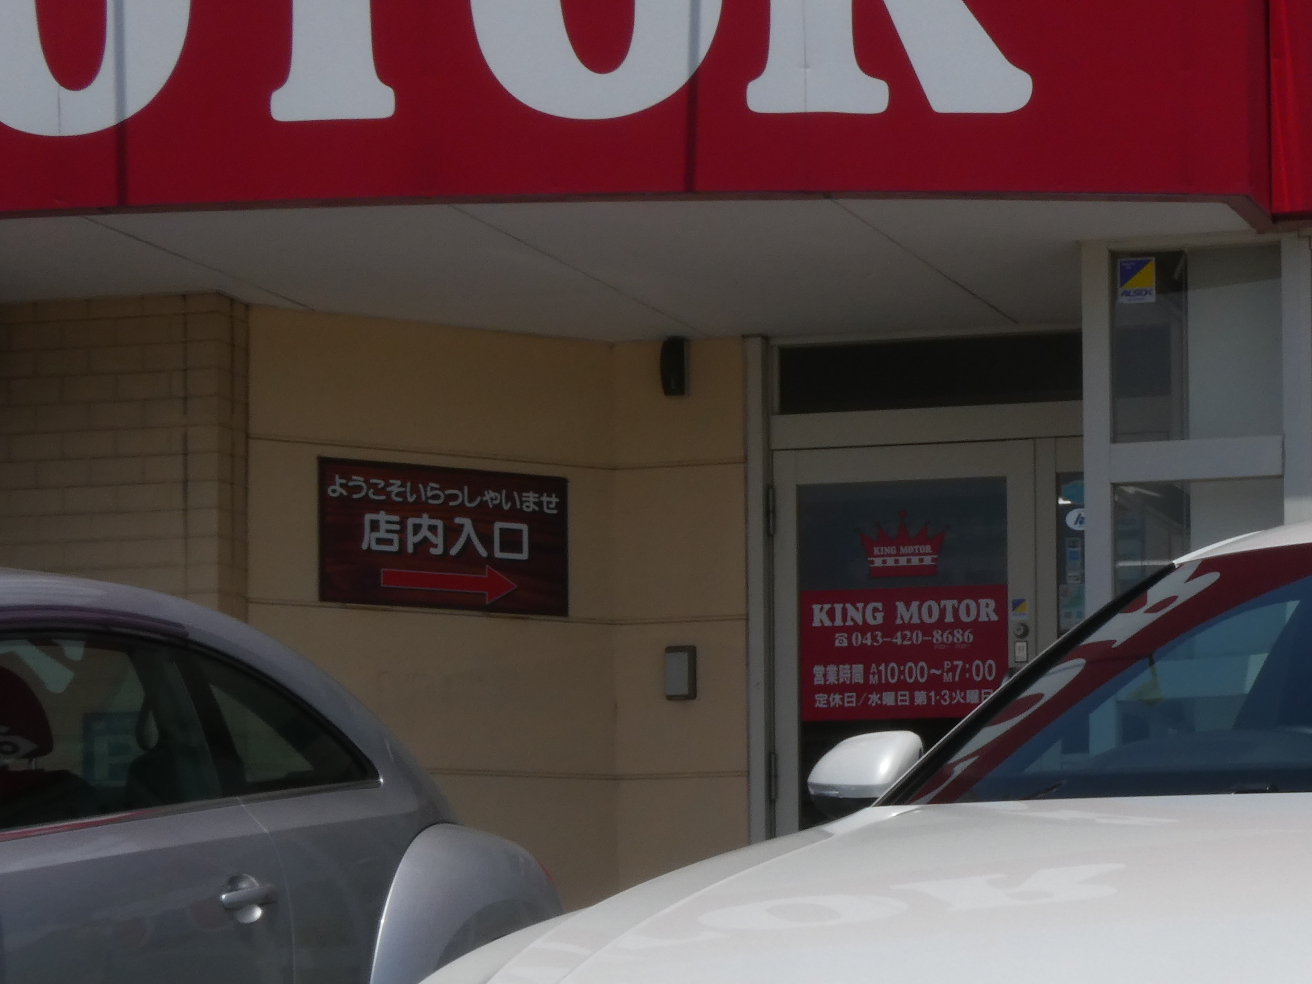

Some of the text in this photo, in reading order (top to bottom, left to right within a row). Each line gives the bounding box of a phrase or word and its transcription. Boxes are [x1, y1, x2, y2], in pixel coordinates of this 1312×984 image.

[327, 474, 560, 514] ようこそいらっしゃいませ
[361, 511, 529, 560] 店内入口
[873, 544, 933, 556] KING MOTOR
[812, 598, 999, 627] KING MOTOR
[852, 629, 974, 647] 043-420-8686
